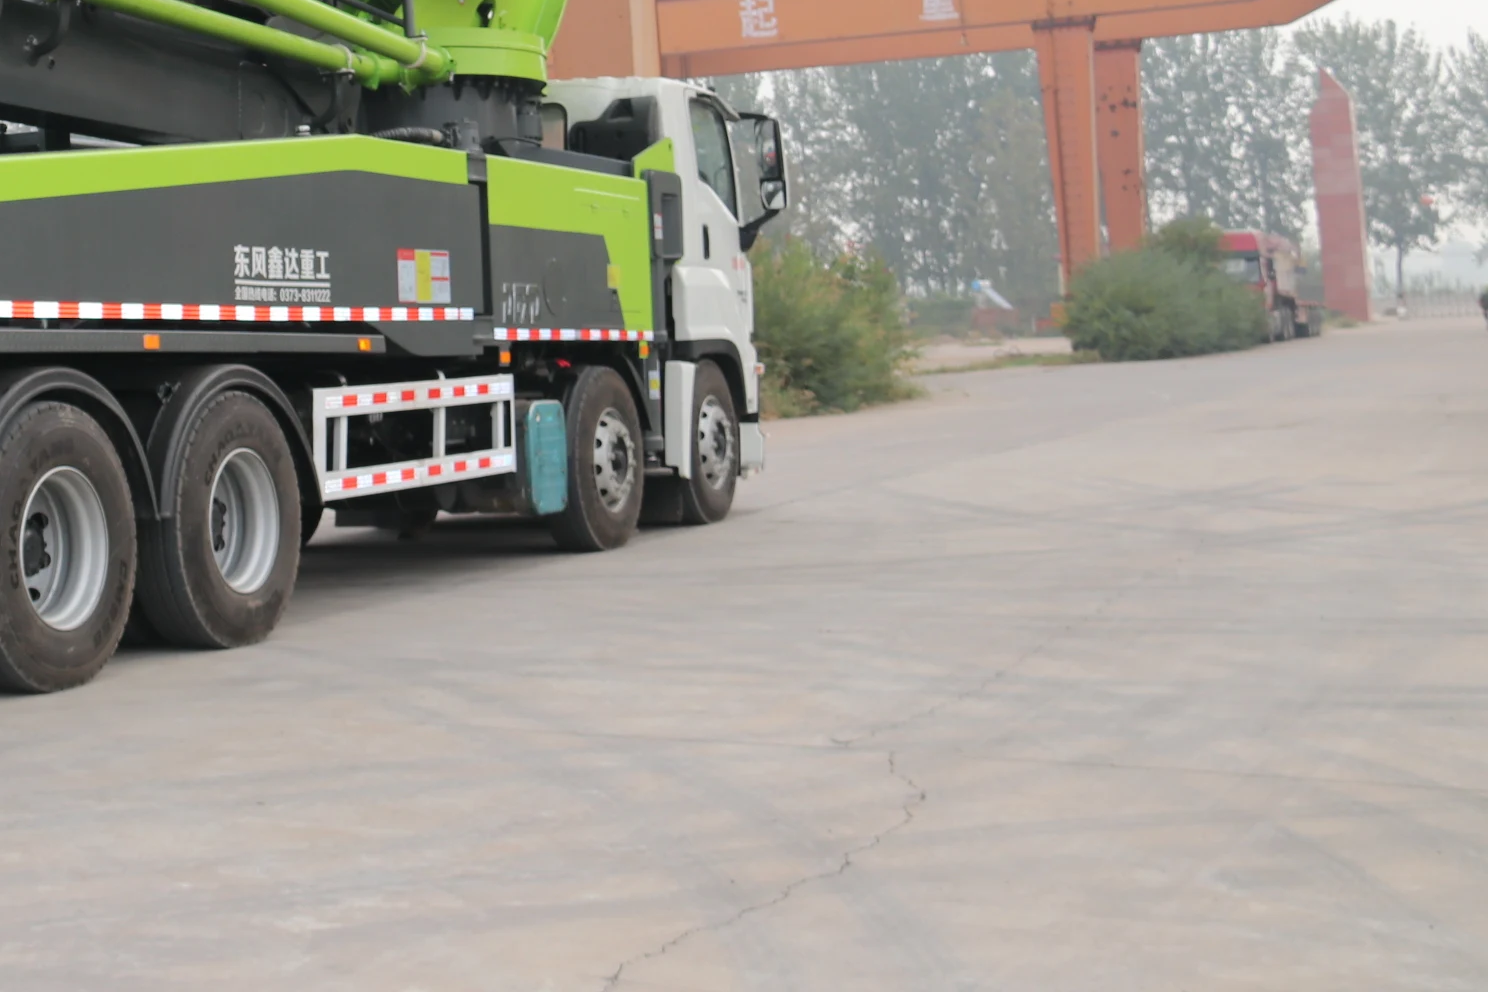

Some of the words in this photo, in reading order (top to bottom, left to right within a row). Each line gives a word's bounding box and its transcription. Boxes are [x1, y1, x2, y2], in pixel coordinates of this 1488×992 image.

[233, 244, 331, 280] 东风鑫达重工
